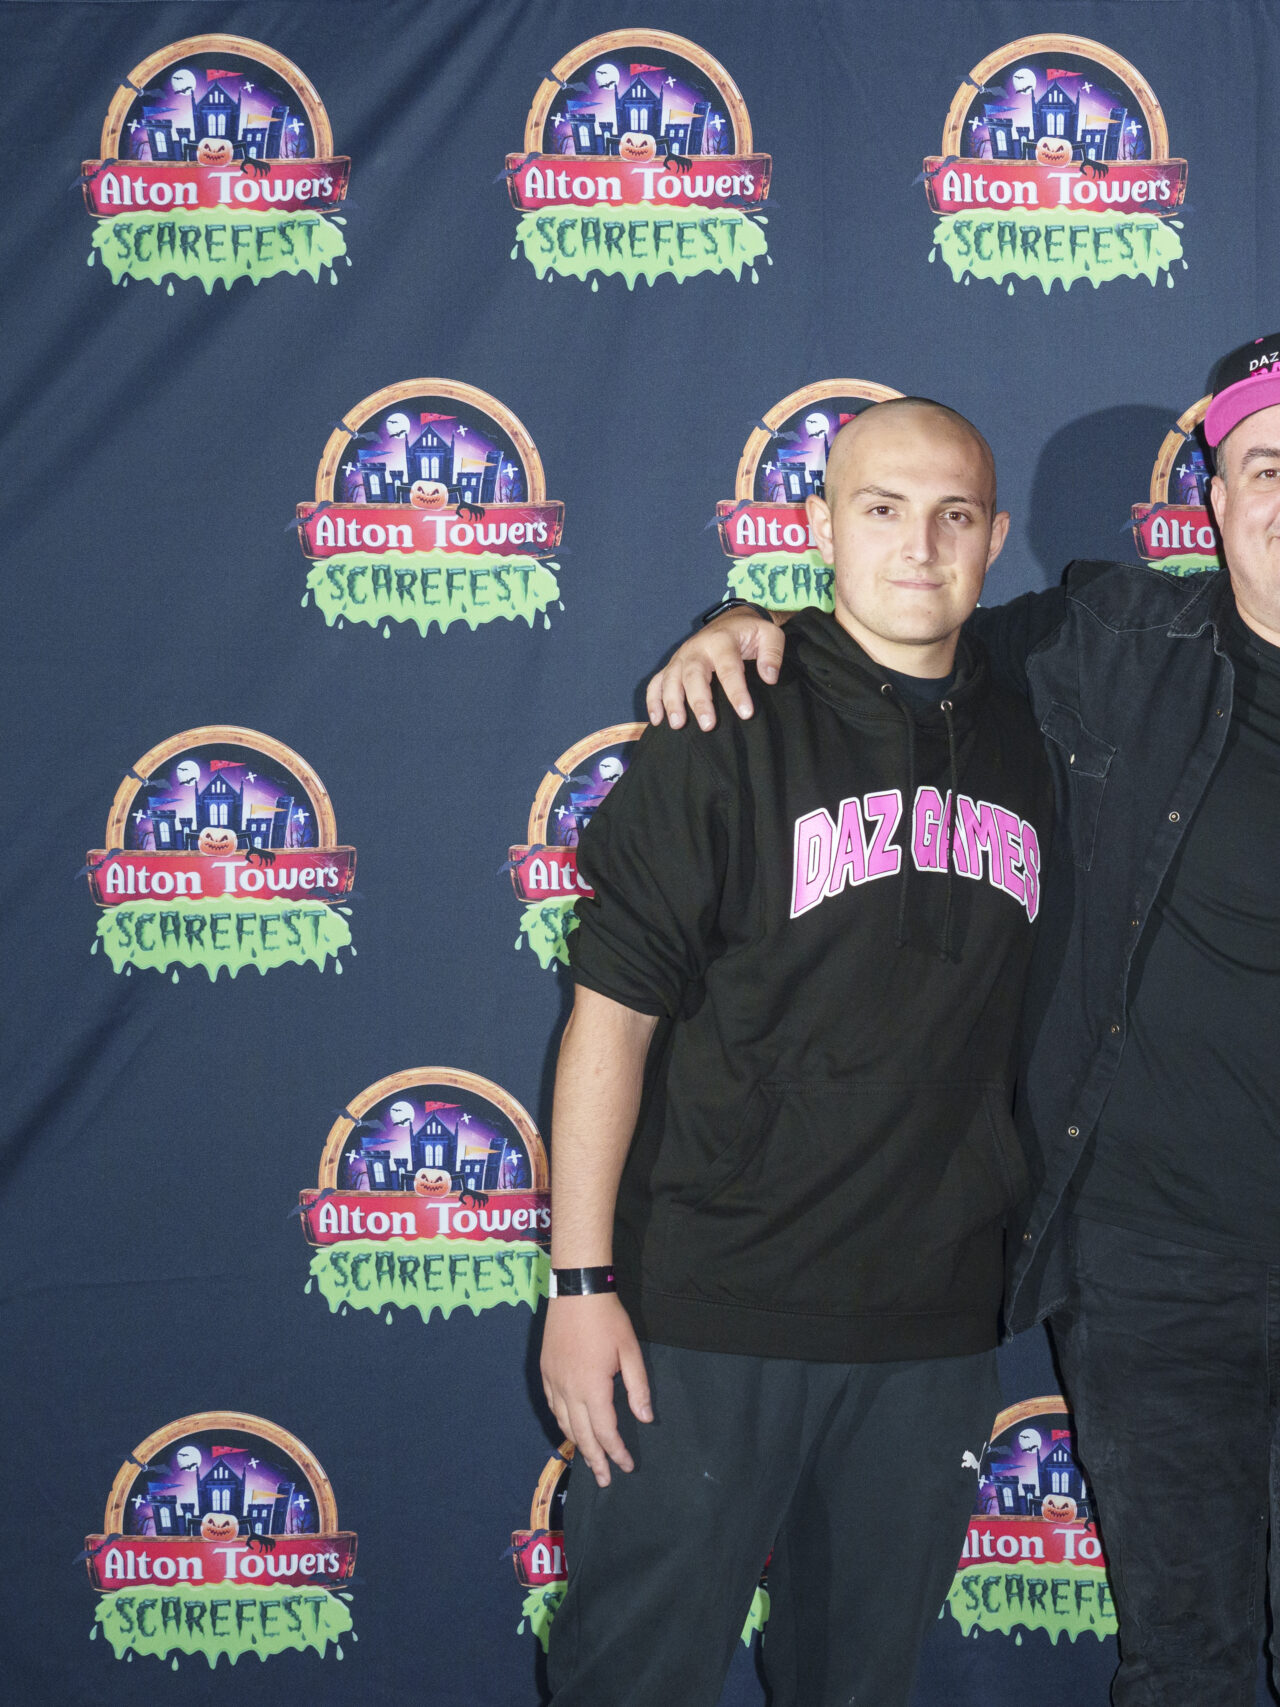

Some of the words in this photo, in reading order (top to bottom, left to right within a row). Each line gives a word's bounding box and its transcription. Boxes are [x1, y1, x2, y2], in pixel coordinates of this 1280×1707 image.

[101, 173, 198, 205] Alton
[208, 171, 333, 203] Towers
[525, 167, 622, 200] Alton
[631, 166, 754, 200] Towers
[943, 170, 1038, 204] Alton
[1048, 171, 1170, 206] Towers
[113, 220, 319, 261] SCAREFEST
[537, 218, 741, 256] SCAREFEST
[954, 222, 1159, 263] SCAREFEST
[1249, 351, 1279, 371] DAZ
[316, 515, 413, 547] Alton
[422, 515, 547, 548] Towers
[327, 565, 536, 608] SCAREFEST
[790, 789, 902, 919] DAZ
[911, 786, 1040, 923] GAMES
[107, 863, 202, 894] Alton
[211, 860, 338, 894] Towers
[116, 910, 320, 950] SCAREFEST
[319, 1202, 416, 1234] Alton
[426, 1202, 550, 1235] Towers
[330, 1250, 540, 1292] SCAREFEST
[106, 1548, 203, 1579] Alton
[213, 1547, 339, 1578] Towers
[115, 1595, 327, 1637] SCAREFEST
